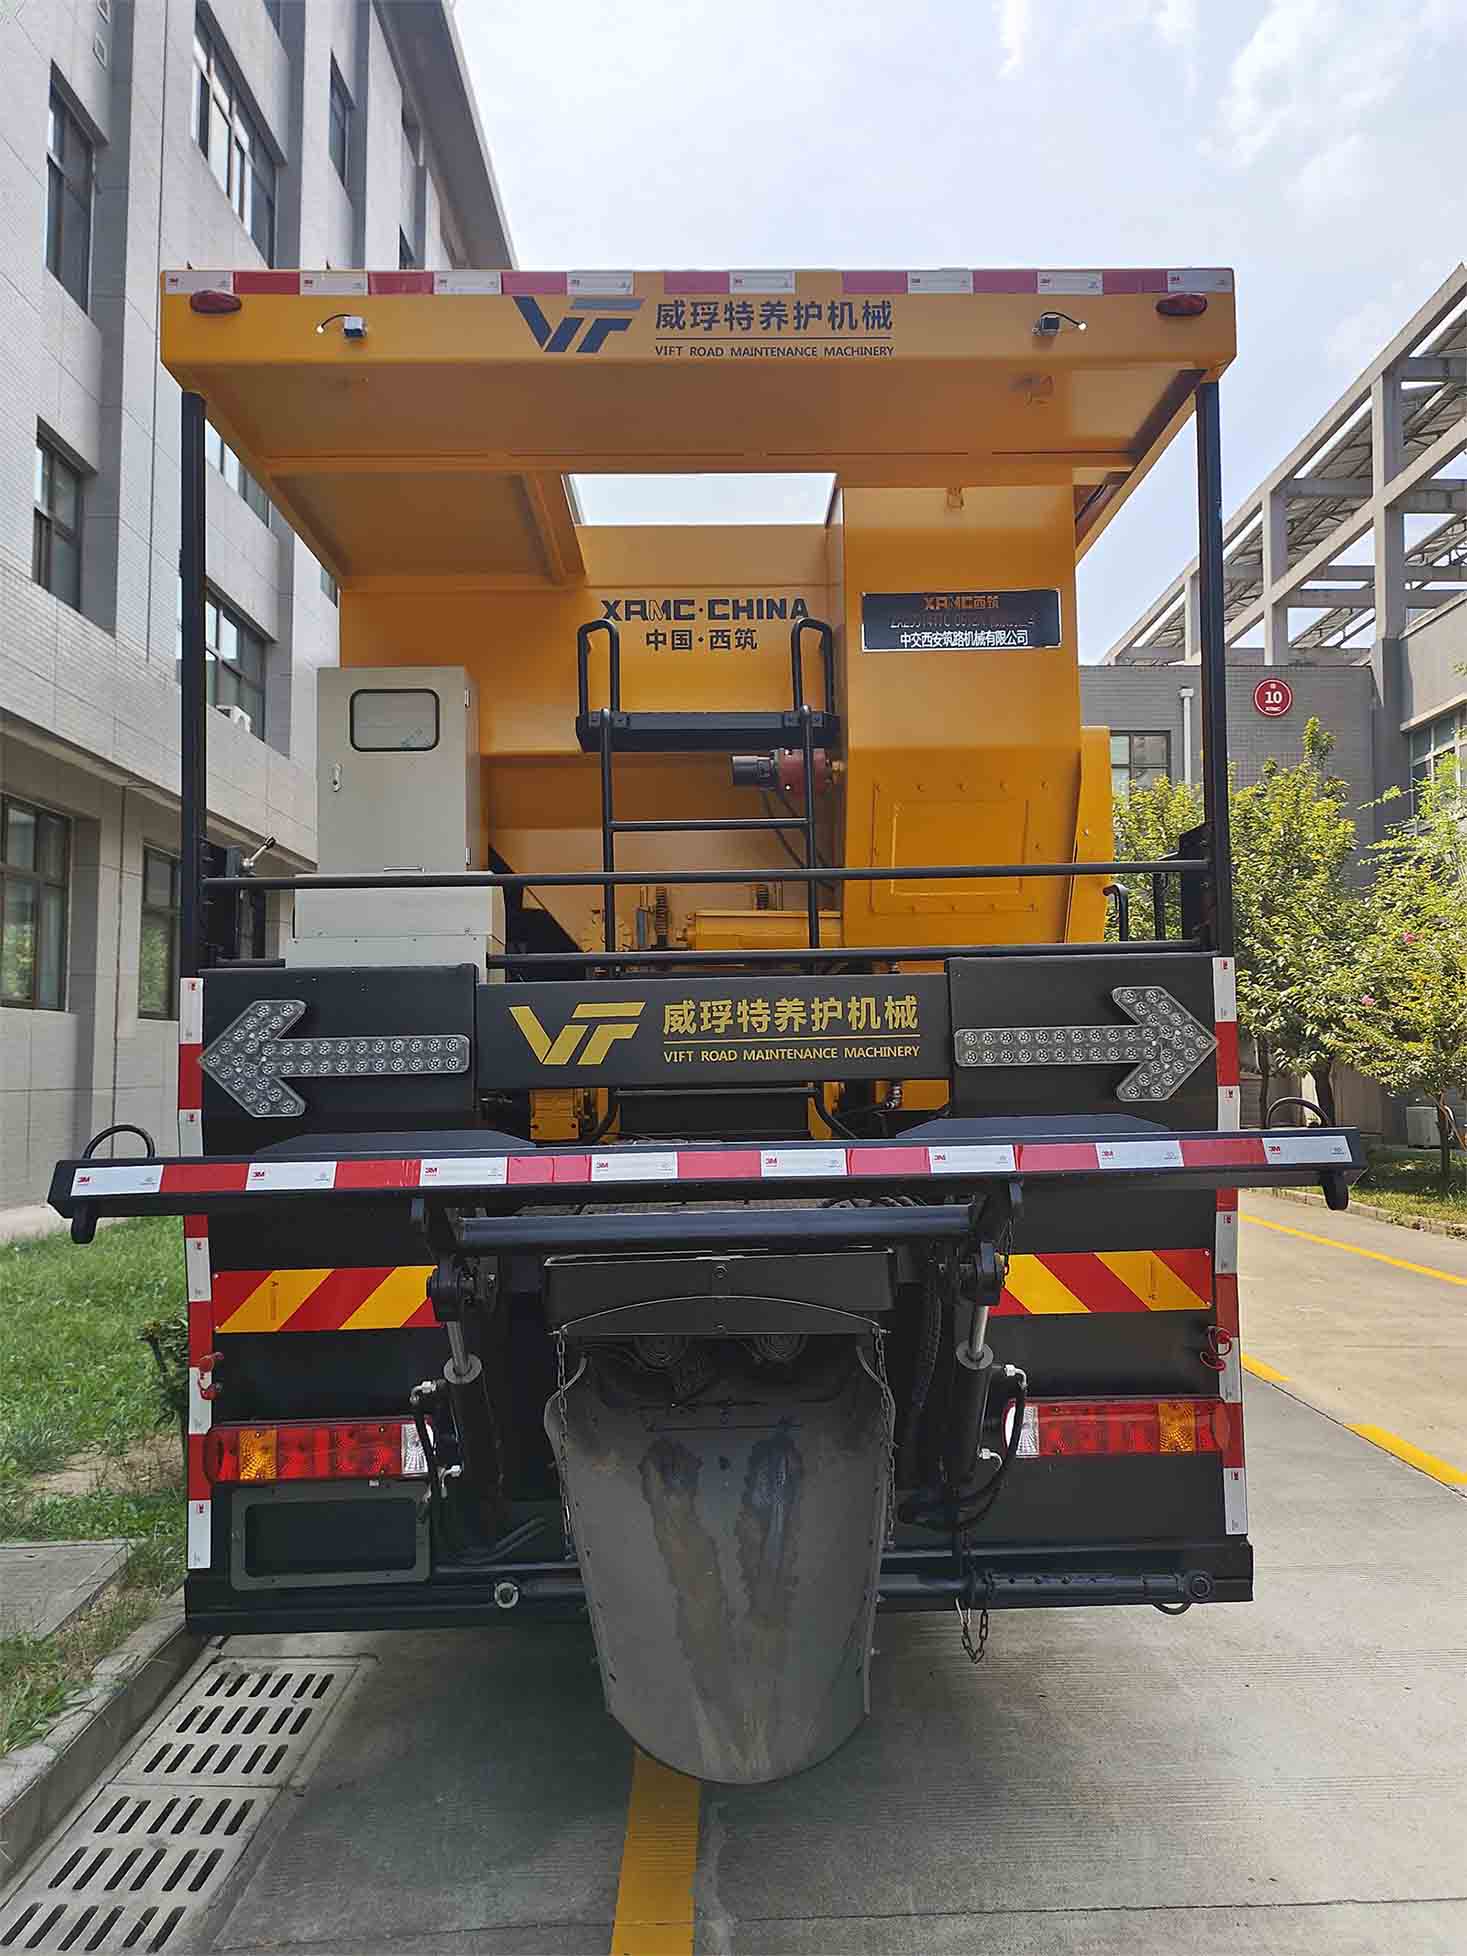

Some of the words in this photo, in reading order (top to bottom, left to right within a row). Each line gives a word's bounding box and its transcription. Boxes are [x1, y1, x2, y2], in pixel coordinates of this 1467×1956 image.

[656, 346, 683, 356] VIFT
[690, 347, 724, 357] ROAD
[731, 347, 817, 357] MAINTENANCE
[824, 346, 894, 357] MACHINERY
[900, 629, 1028, 648] 中交西安筑路机械有限公司
[1265, 691, 1282, 704] 10
[664, 1050, 693, 1063] VIFT
[701, 1049, 737, 1062] ROAD
[743, 1047, 838, 1061] MAINTENANCE
[844, 1046, 920, 1058] MACHINERY
